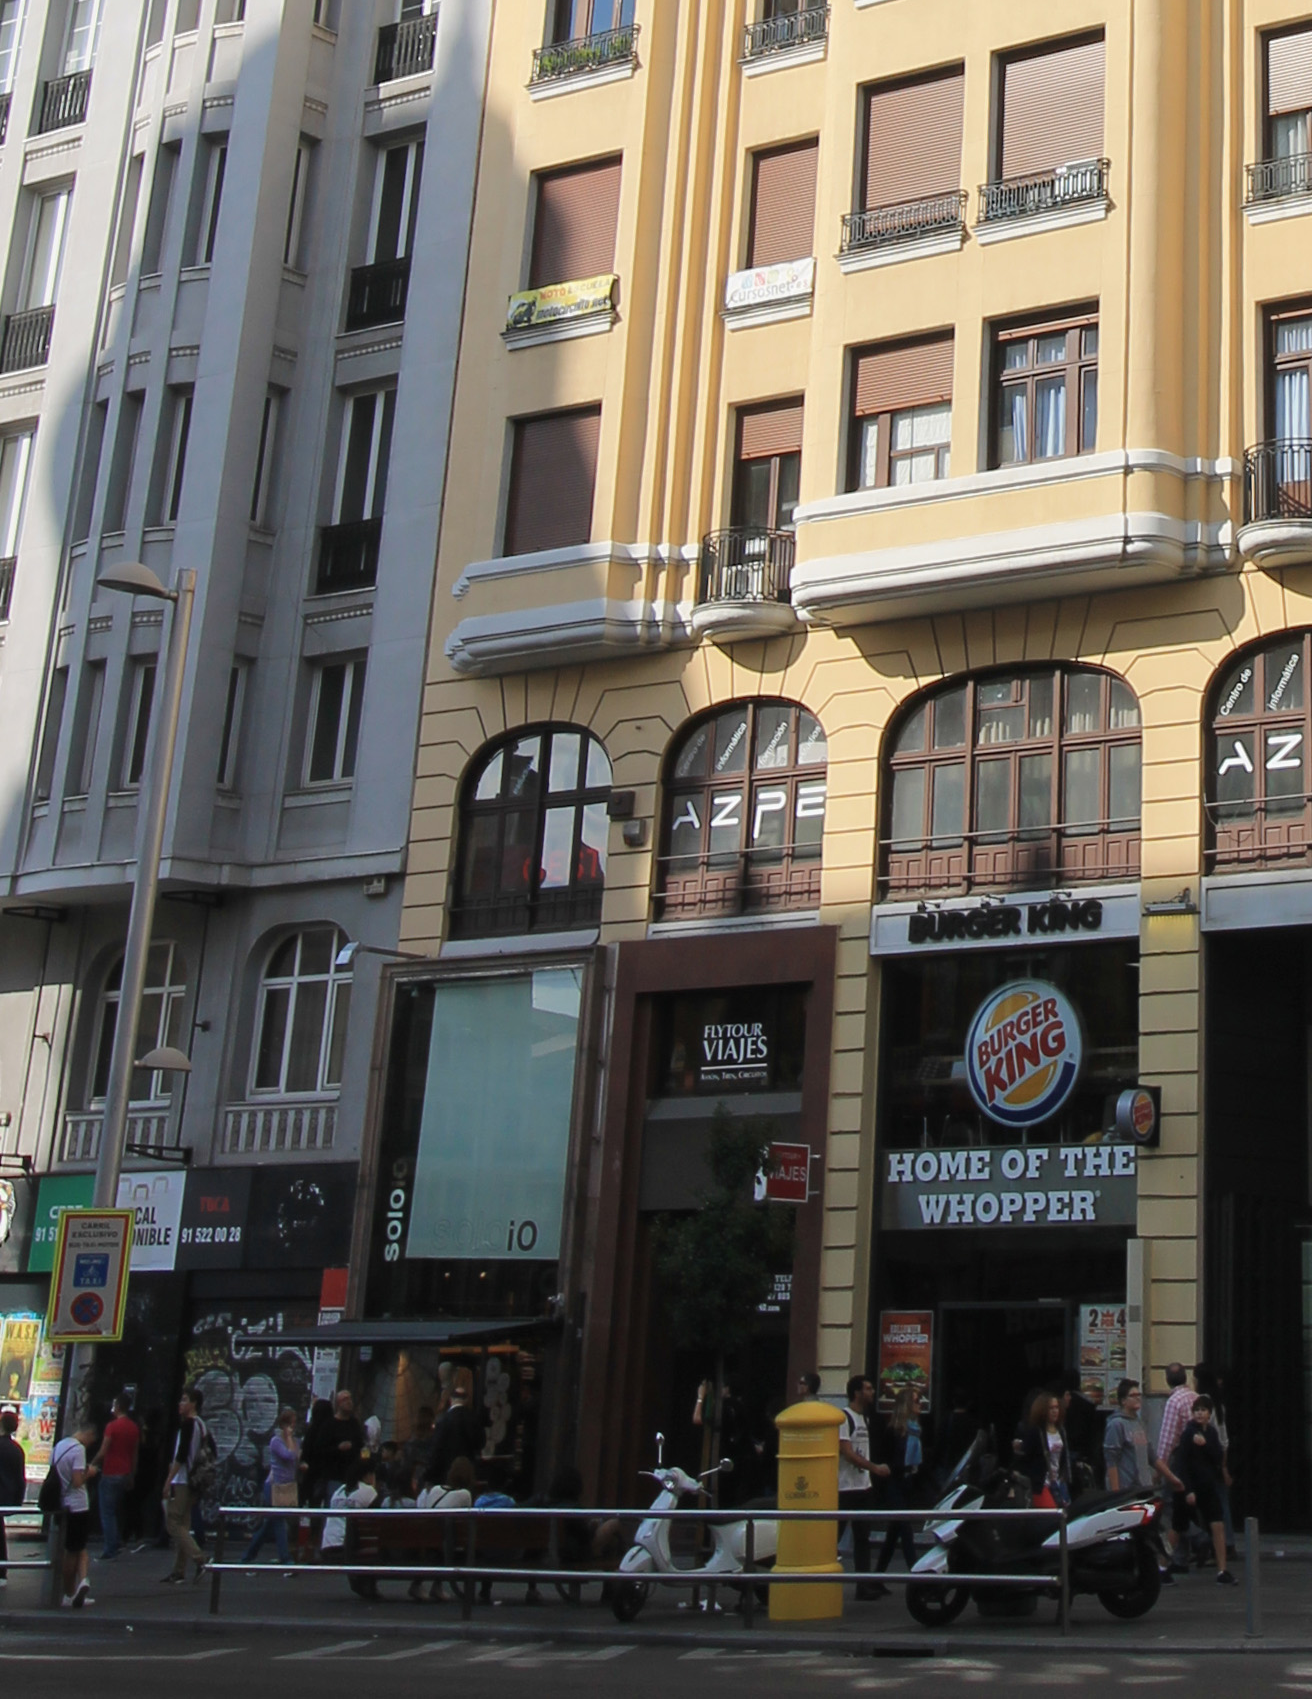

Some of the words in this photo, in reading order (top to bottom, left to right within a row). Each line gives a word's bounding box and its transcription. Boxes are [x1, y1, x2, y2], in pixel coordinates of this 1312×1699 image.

[540, 287, 567, 301] MOTO
[1220, 682, 1244, 716] Centro
[1240, 668, 1252, 684] de
[672, 786, 828, 839] AZPE
[908, 905, 1022, 944] BURGER
[1027, 900, 1103, 934] KING
[704, 1022, 763, 1039] FLYTOUR
[977, 998, 1058, 1070] BURGER
[703, 1036, 768, 1063] VIAJES
[984, 1020, 1066, 1105] KING
[888, 1150, 991, 1183] HOME
[1001, 1148, 1049, 1180] OF
[1059, 1146, 1136, 1178] THE
[130, 1206, 157, 1225] CAL
[918, 1190, 1096, 1224] WHOPPER
[72, 1231, 119, 1239] EXCLUSIVO
[81, 1222, 110, 1230] CARRIL
[181, 1228, 194, 1244] 91
[194, 1228, 213, 1243] 522
[214, 1227, 228, 1242] 00
[228, 1227, 242, 1243] 28
[1088, 1308, 1099, 1328] 2
